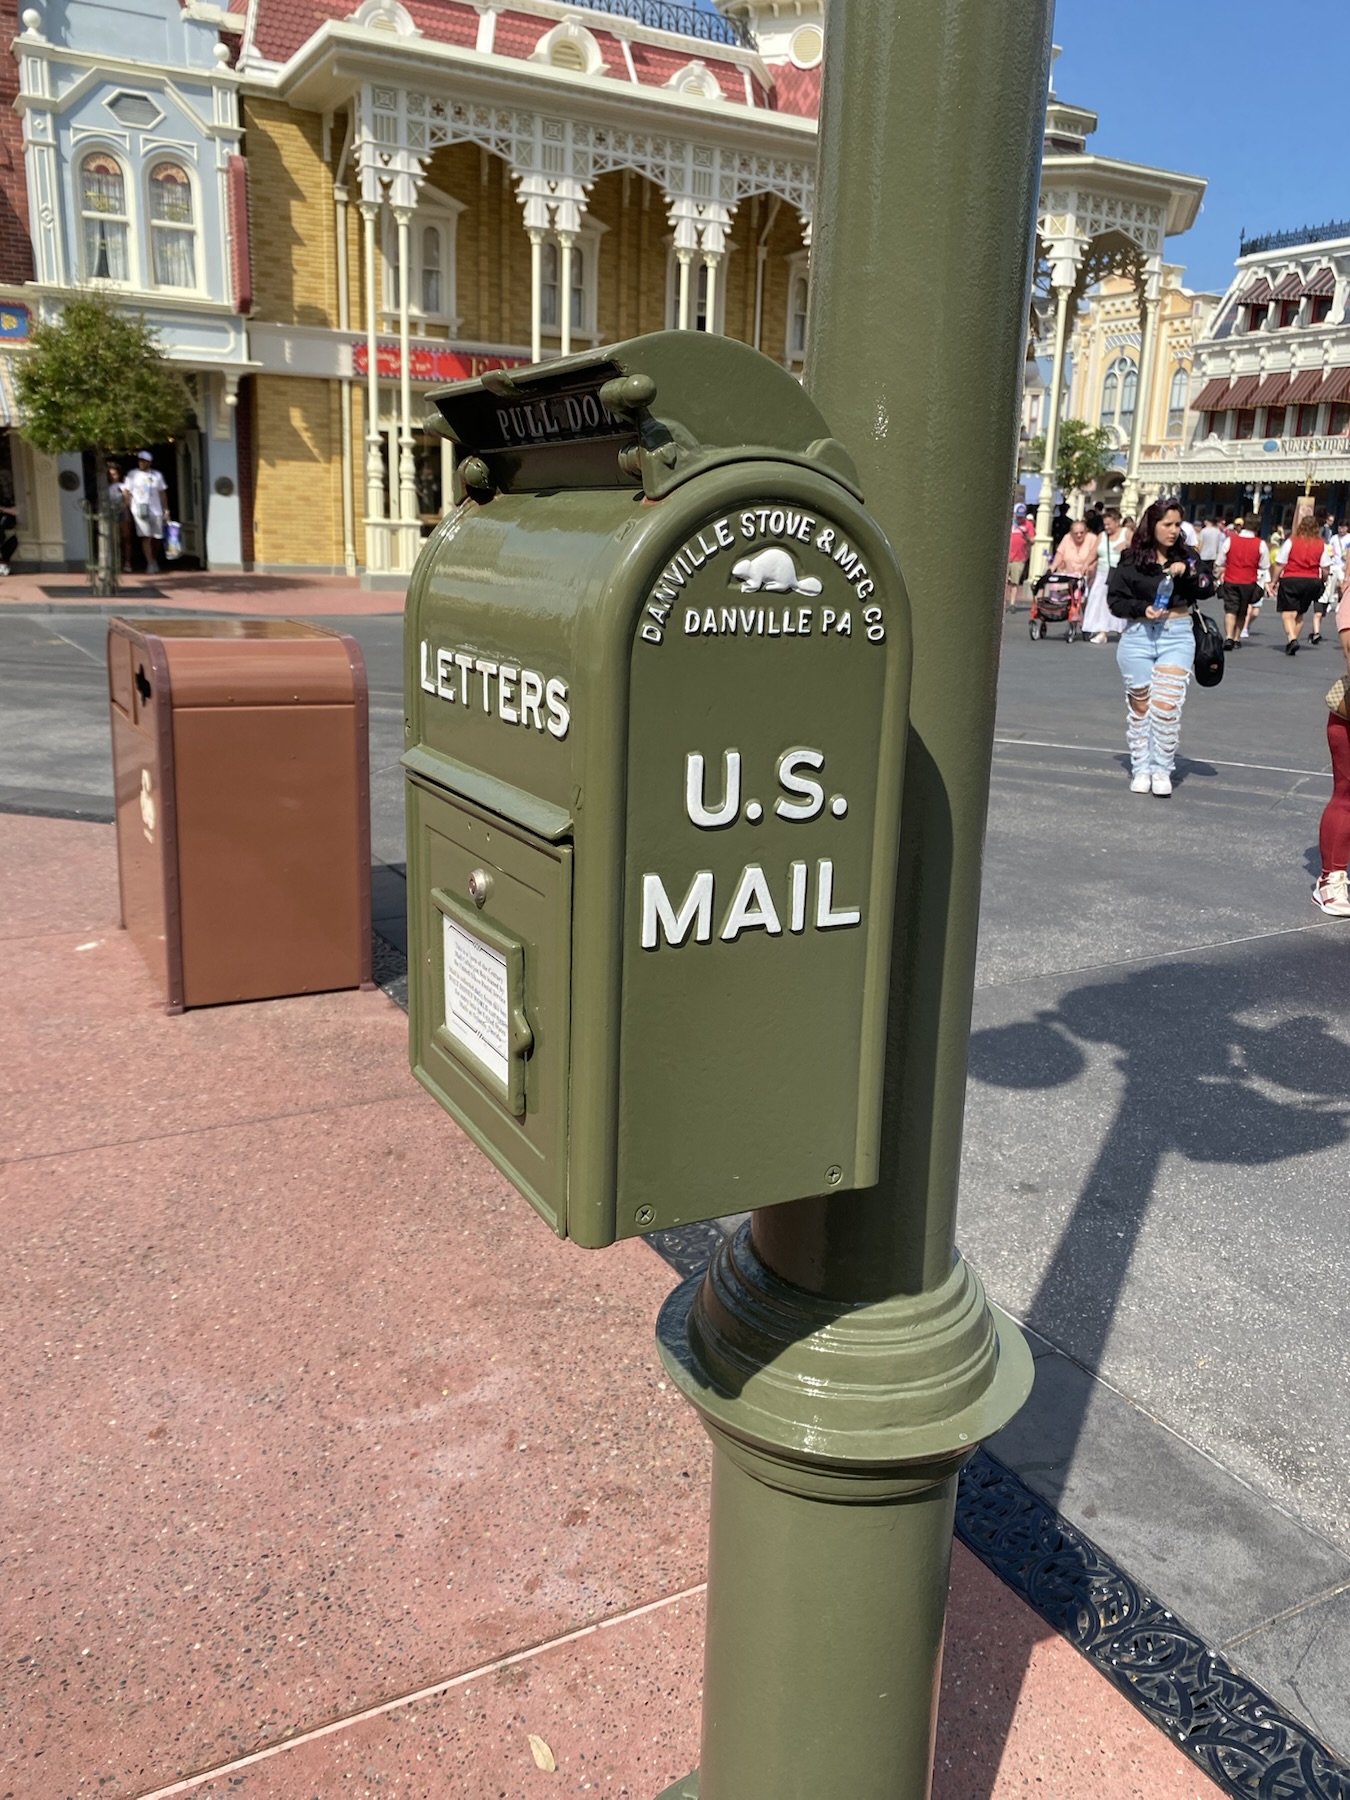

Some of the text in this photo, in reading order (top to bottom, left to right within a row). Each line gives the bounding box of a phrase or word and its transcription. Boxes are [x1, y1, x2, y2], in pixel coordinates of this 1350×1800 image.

[496, 401, 560, 440] PULL
[642, 519, 735, 643] DANVILLE
[740, 509, 815, 542] STOVE
[816, 528, 835, 553] &
[865, 607, 885, 641] CO
[685, 606, 852, 635] DANVILLE PA
[420, 640, 571, 738] LETTERS
[686, 748, 848, 828] U.S.
[641, 858, 860, 949] MAIL
